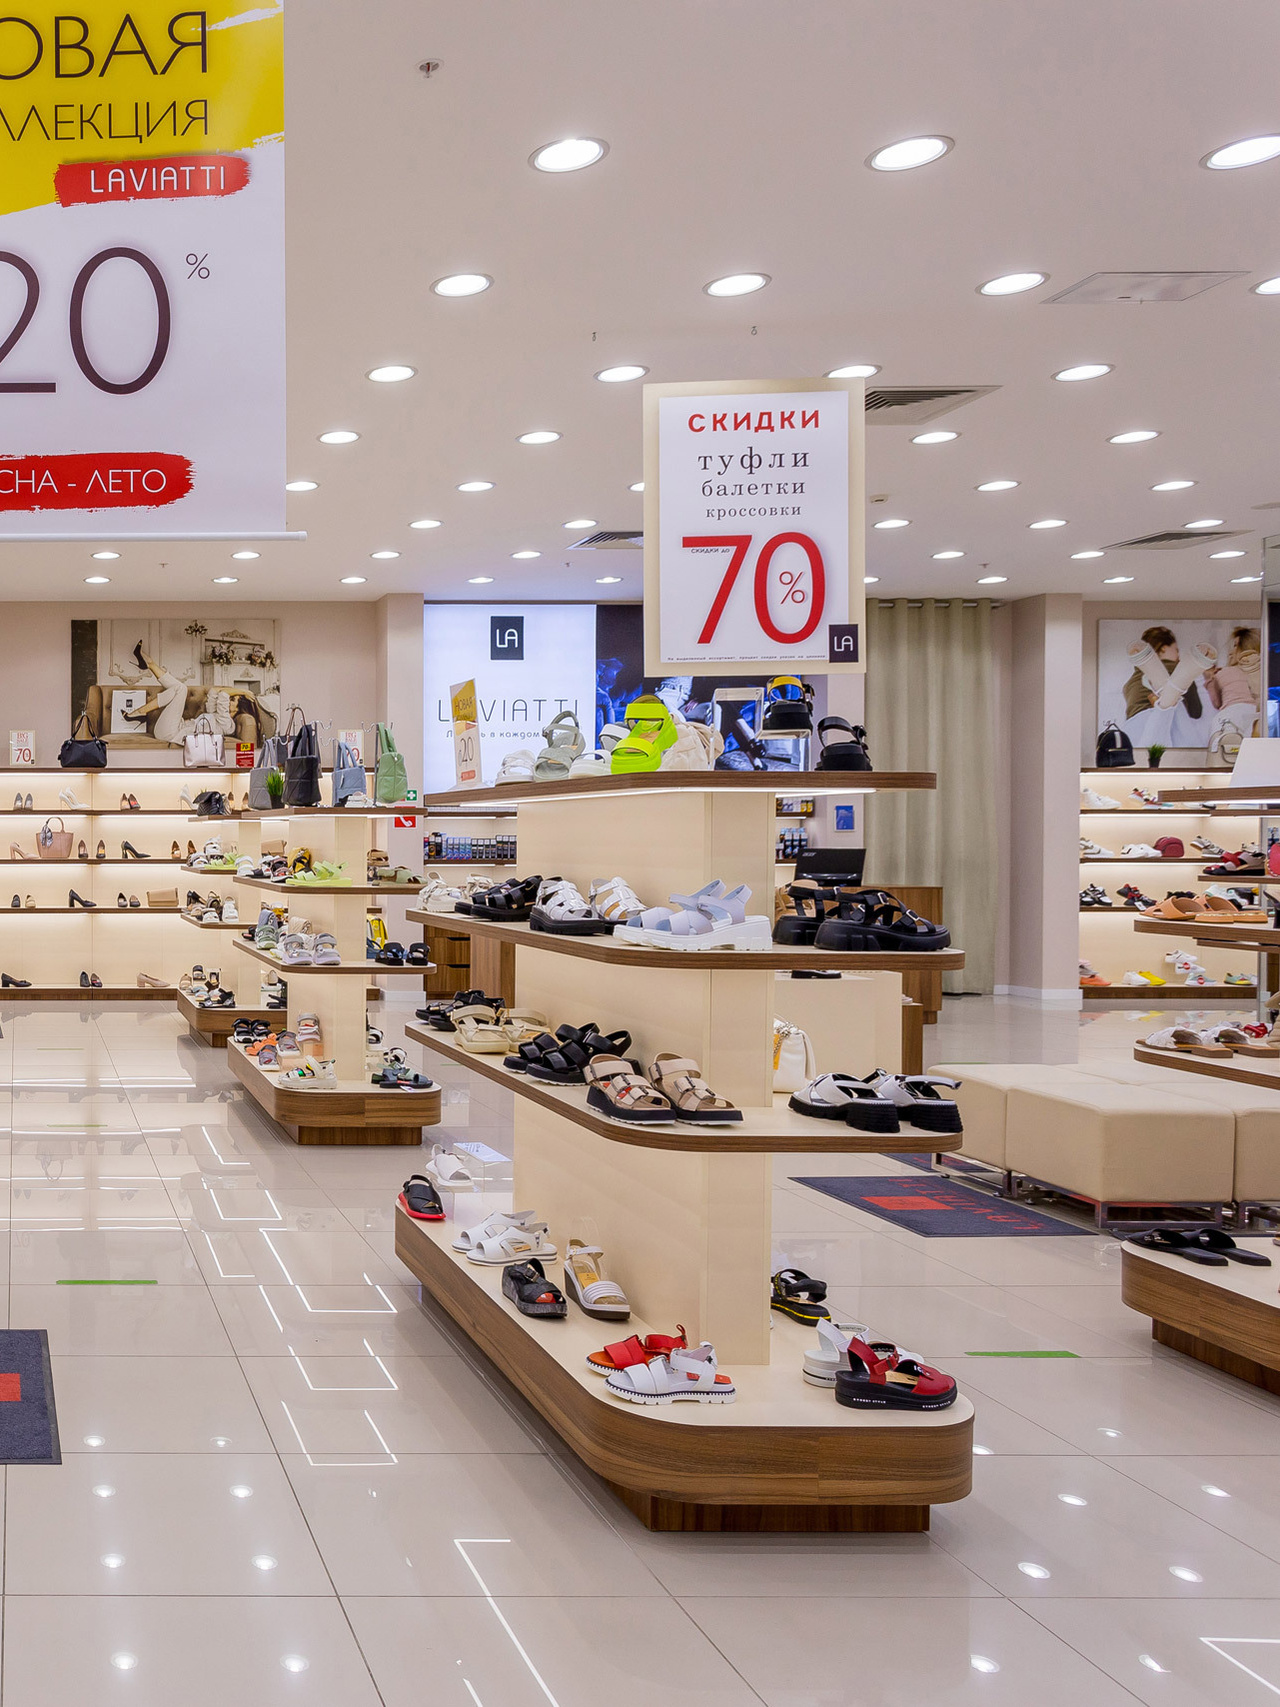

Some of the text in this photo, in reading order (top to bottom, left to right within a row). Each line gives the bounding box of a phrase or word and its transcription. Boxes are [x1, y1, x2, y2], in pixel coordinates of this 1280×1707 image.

[89, 165, 226, 194] LAVIATTI
[687, 409, 821, 433] СКИДКИ
[697, 446, 810, 475] туфли
[86, 468, 167, 495] ЛЕТО
[701, 479, 806, 498] балетки
[705, 505, 802, 521] кроссовки
[681, 531, 826, 645] 70
[496, 628, 519, 648] LA
[833, 635, 854, 652] LA
[438, 698, 578, 722] LVIATTI
[499, 730, 540, 740] каждом
